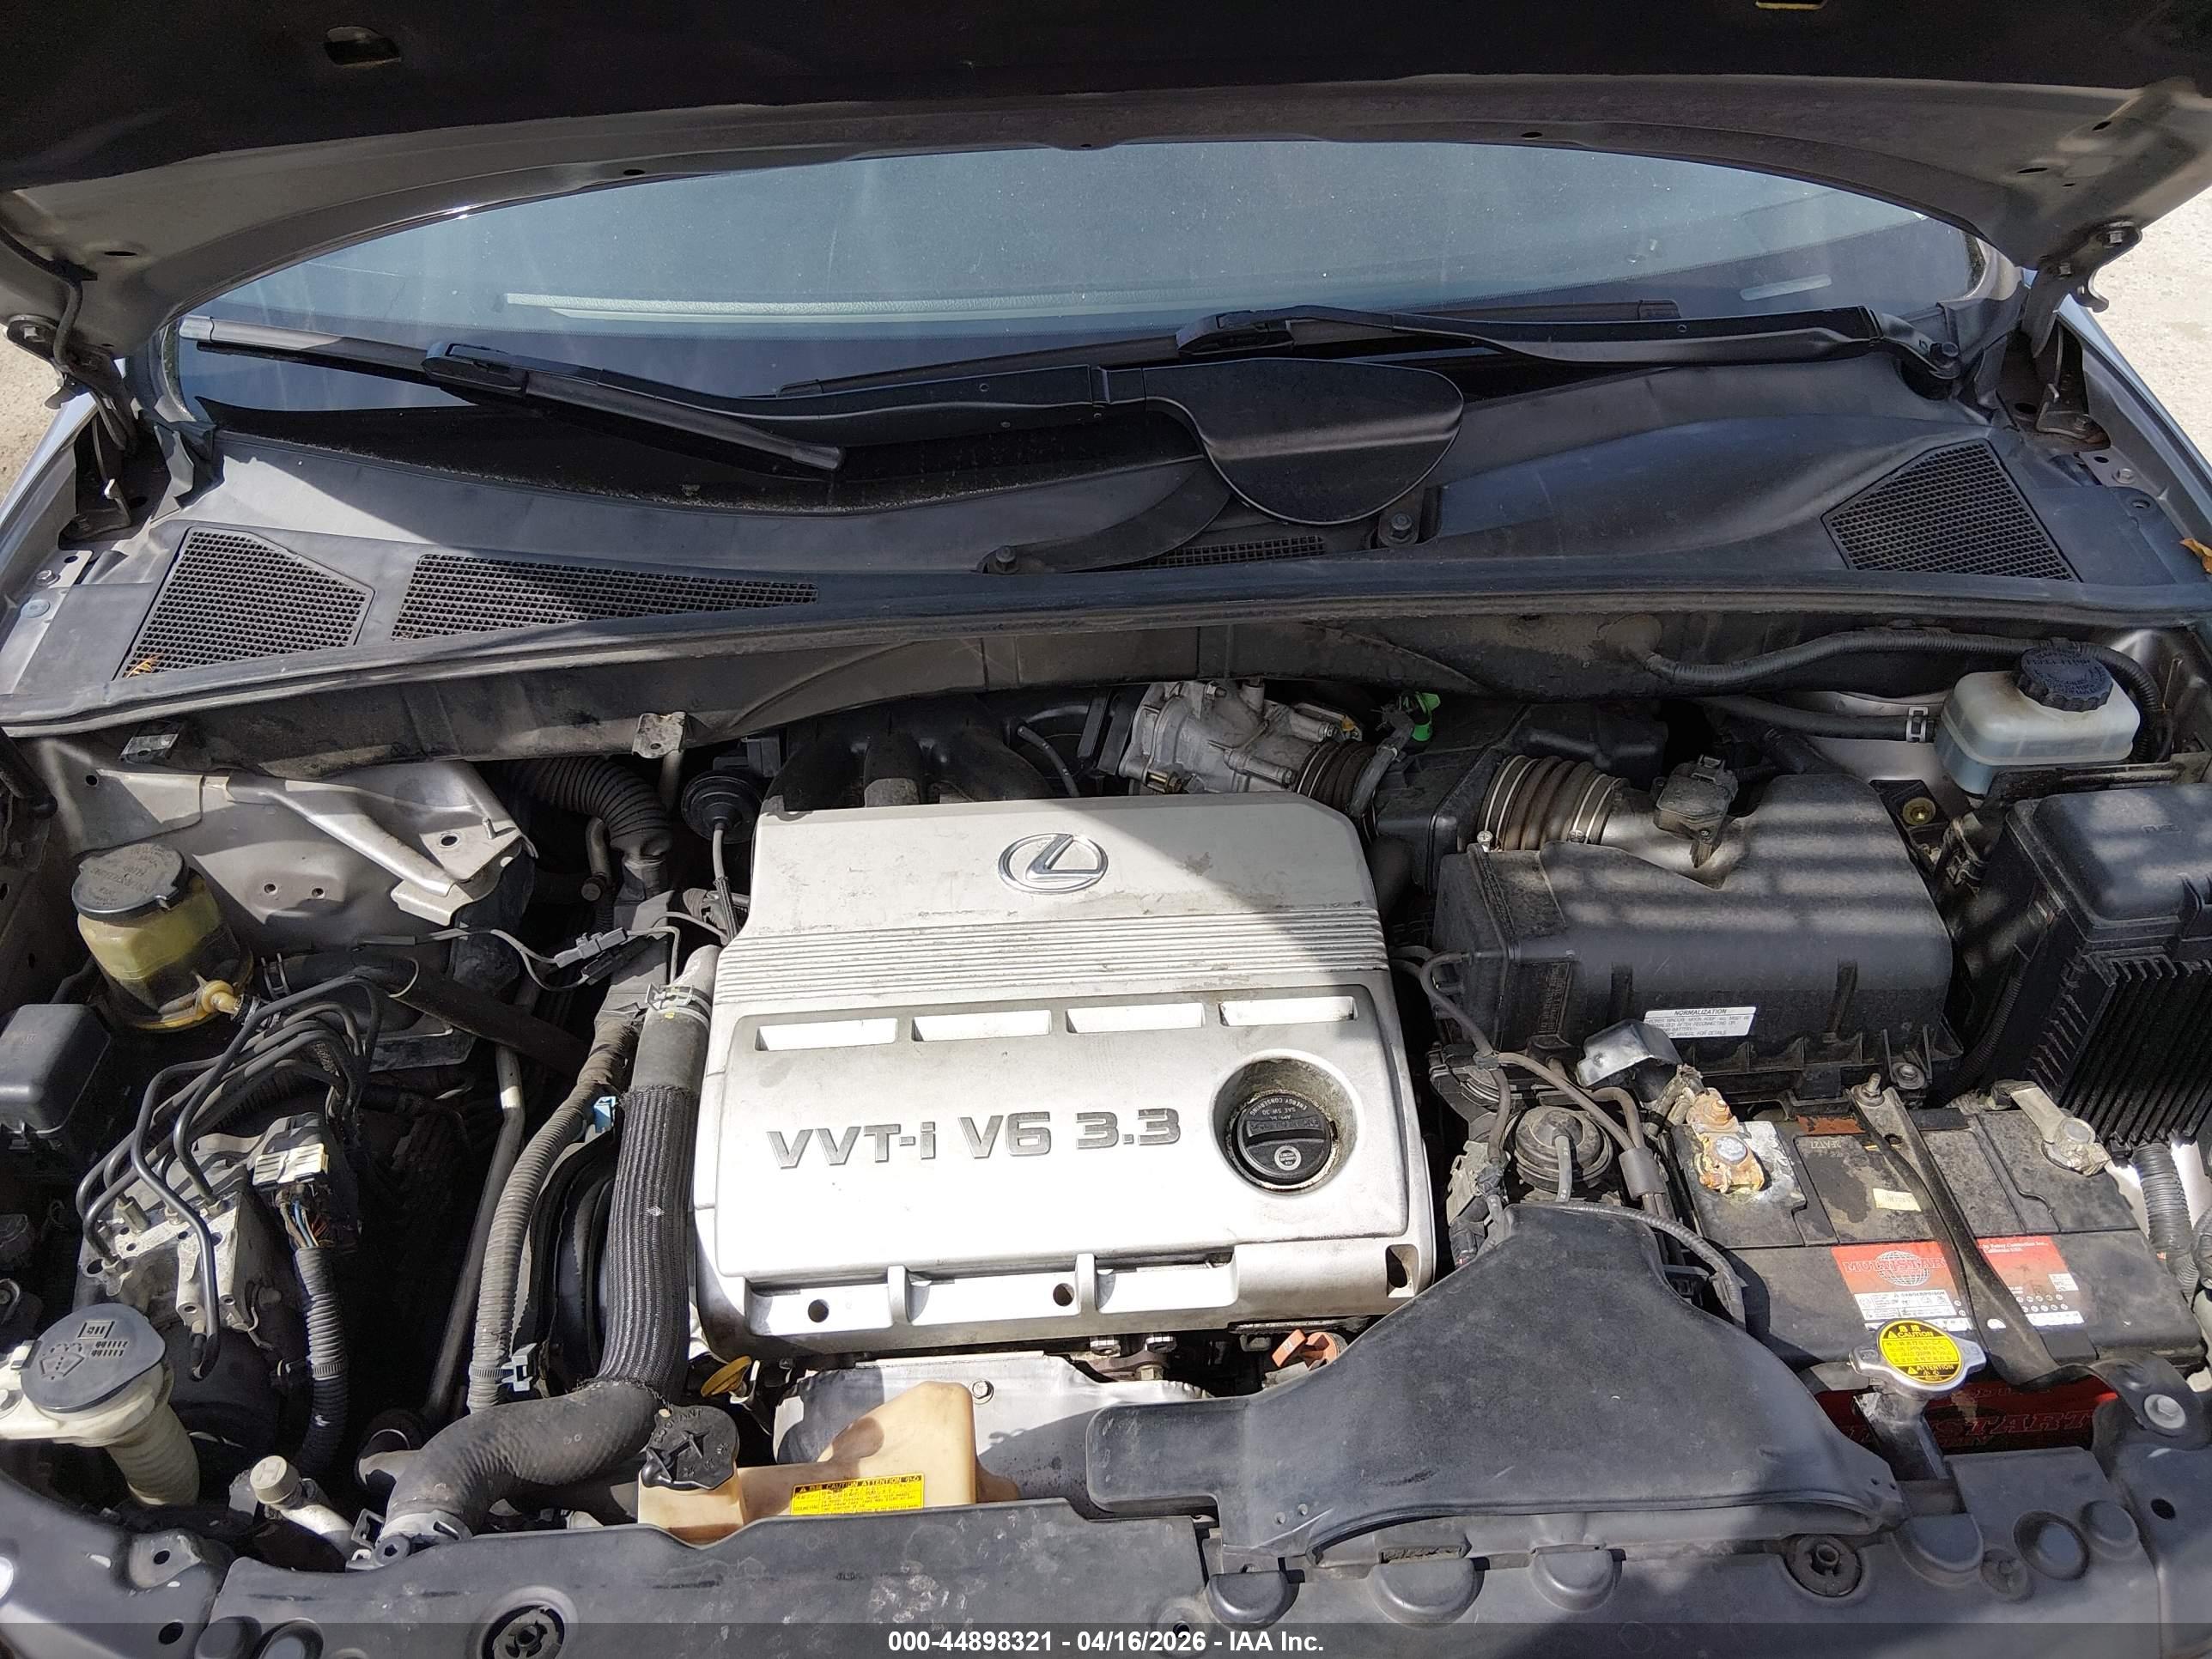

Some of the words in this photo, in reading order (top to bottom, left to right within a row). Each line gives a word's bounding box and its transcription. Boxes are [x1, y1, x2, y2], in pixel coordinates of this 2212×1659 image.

[1249, 1097, 1283, 1116] CONSERVING
[1285, 1098, 1308, 1111] ENERGY
[766, 1121, 937, 1169] VVT-i
[957, 1111, 1052, 1159] V6
[1075, 1108, 1182, 1150] 3.3
[654, 1408, 704, 1443] COOLANT
[826, 1480, 859, 1491] CAUTION
[861, 1477, 902, 1487] ATTENTION
